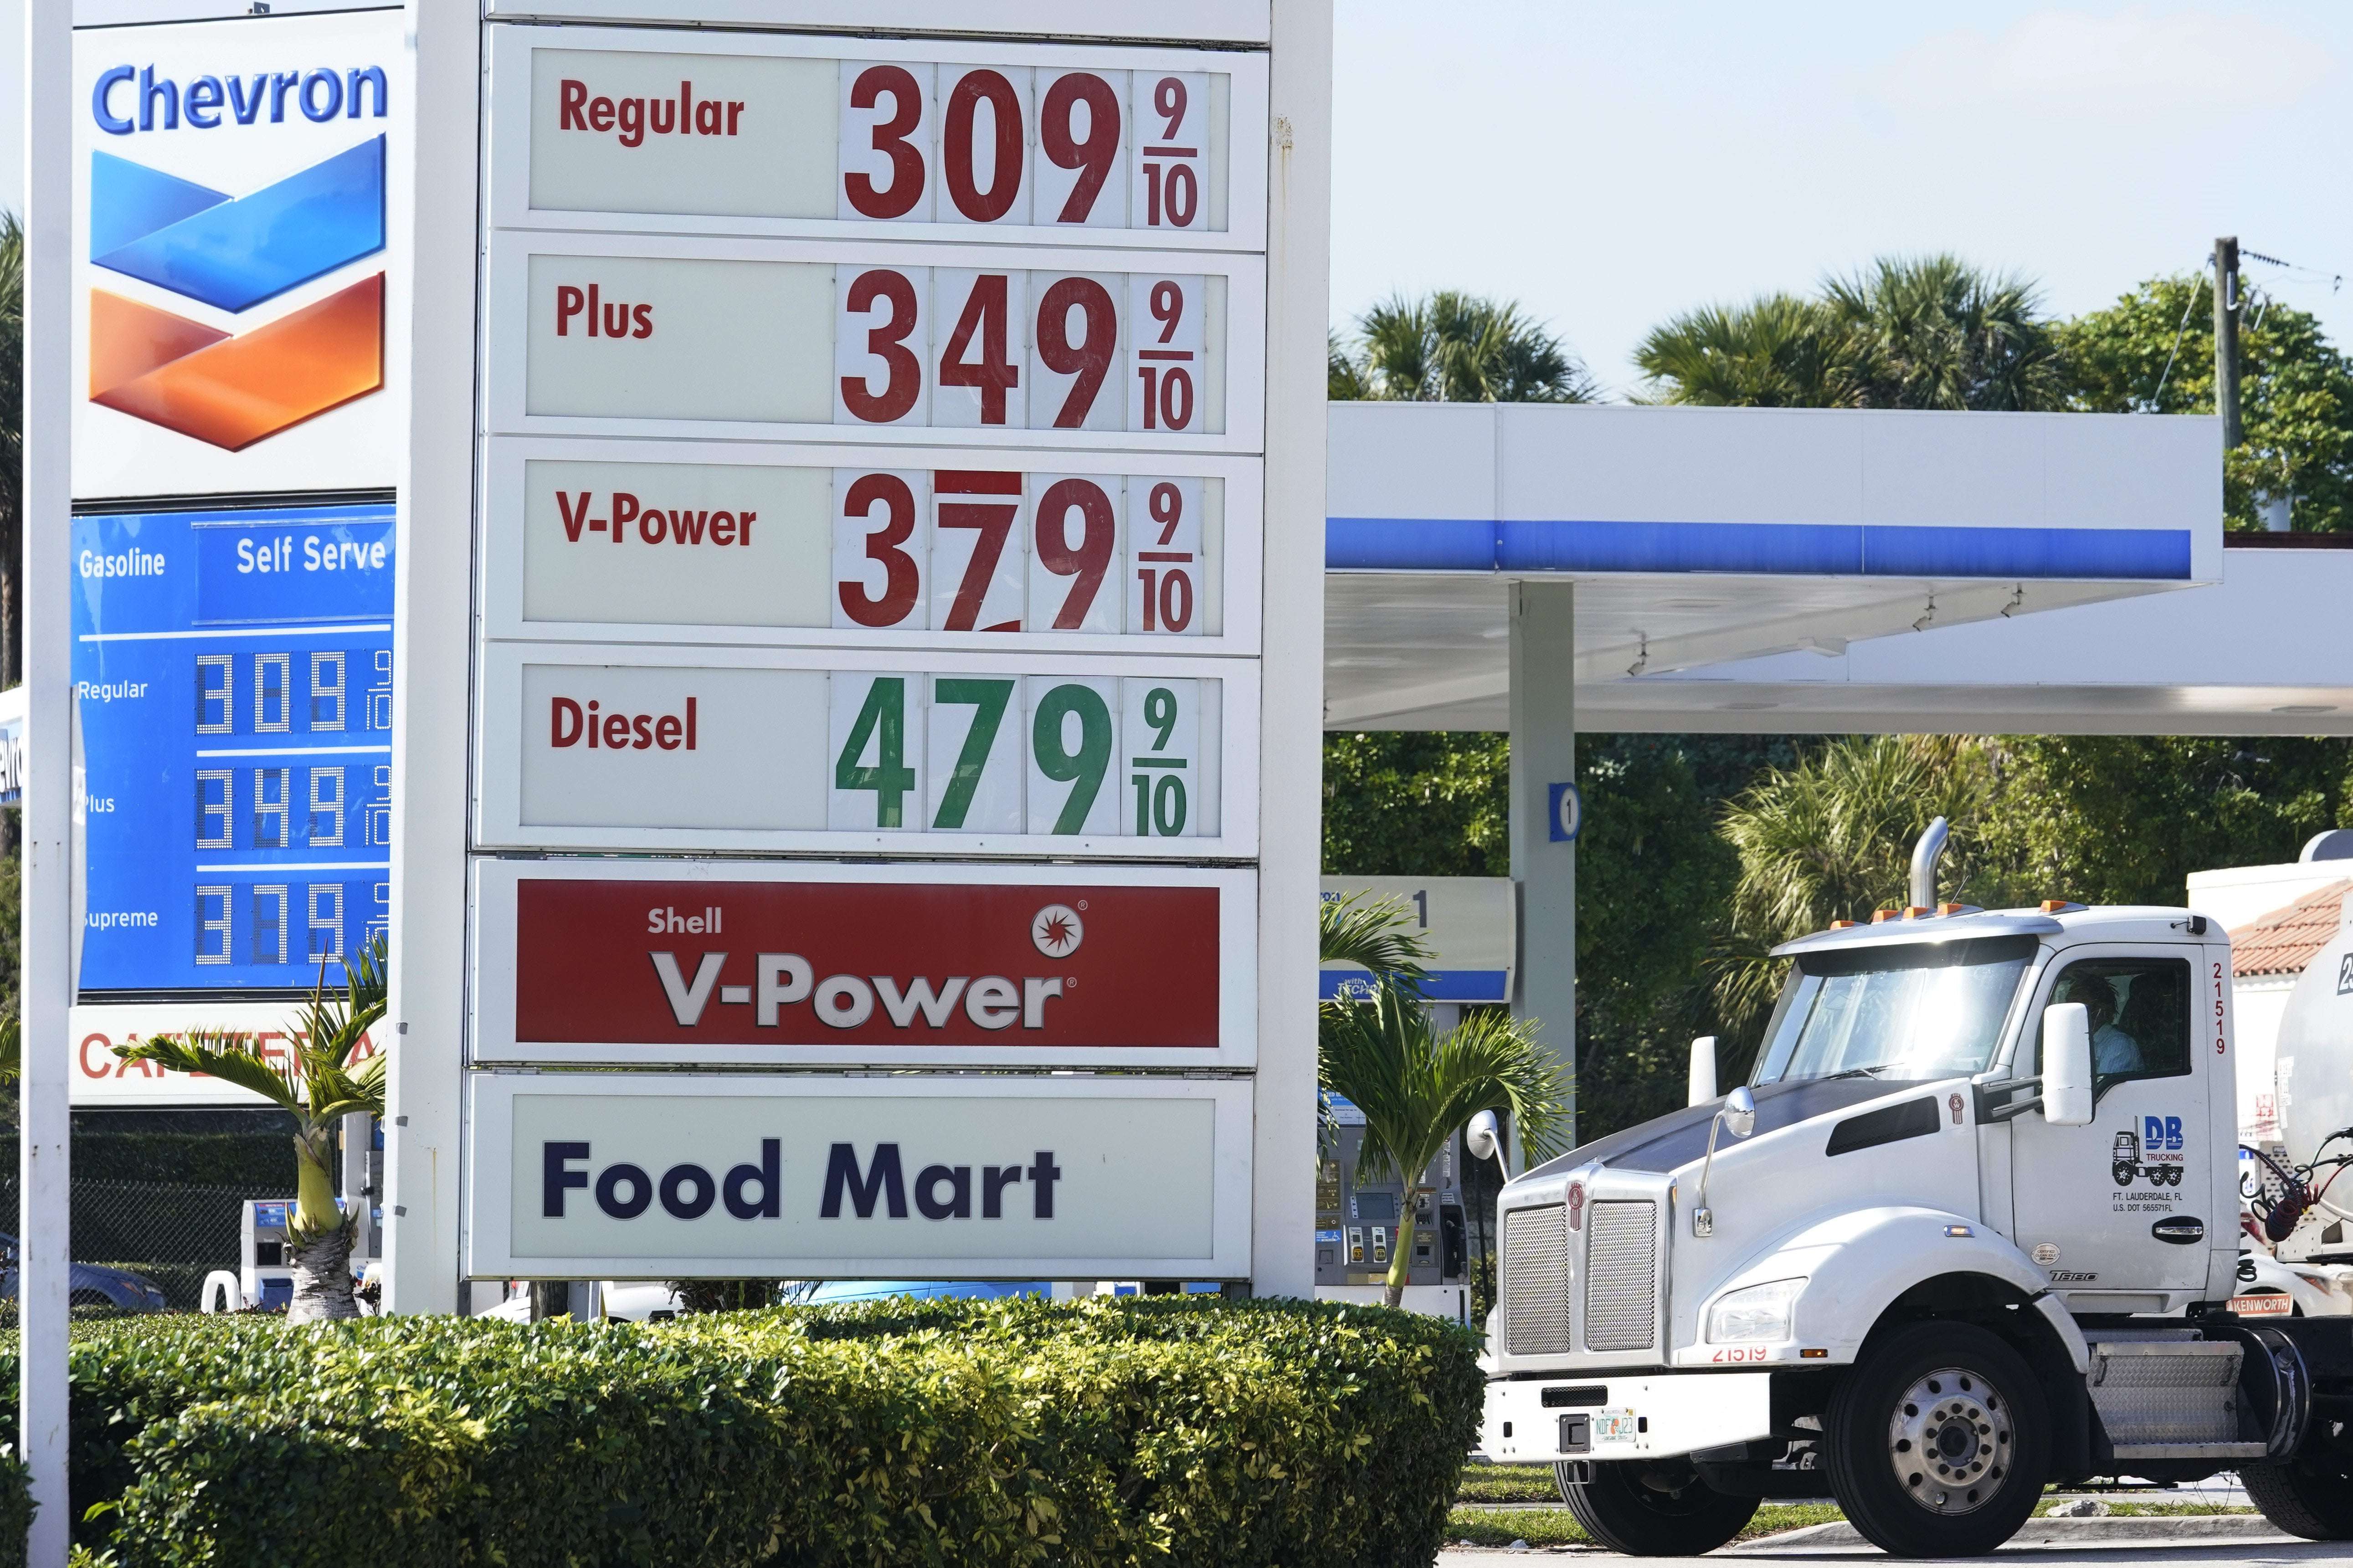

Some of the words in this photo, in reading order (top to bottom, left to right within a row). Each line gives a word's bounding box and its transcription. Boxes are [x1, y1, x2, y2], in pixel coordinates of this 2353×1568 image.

[92, 63, 387, 135] Chevron
[560, 79, 745, 148] Regular
[844, 65, 1120, 223] 309
[556, 283, 653, 340] Plus
[841, 269, 1117, 428] 349
[79, 547, 165, 579] Gasoline
[236, 535, 293, 574] Self
[303, 535, 386, 572] Serve
[555, 491, 757, 547] V-Power
[838, 473, 1115, 632] 379
[78, 679, 148, 703] Regular
[196, 651, 346, 734] 309
[551, 696, 697, 751] Diesel
[835, 677, 1113, 836] 479
[196, 766, 346, 849] 349
[1566, 798, 1572, 825] 1
[648, 907, 722, 935] Shell
[1413, 890, 1427, 928] 1
[649, 952, 1063, 1030] V-Power
[2213, 962, 2225, 1055] 21519
[2145, 1116, 2183, 1150] DB
[542, 1137, 782, 1221] Food
[819, 1142, 1062, 1221] Mart
[2113, 1192, 2123, 1200] FT.
[2126, 1192, 2172, 1202] LAUDERDALE,
[2050, 1270, 2098, 1281] T880
[2235, 1298, 2289, 1312] KENWORTH
